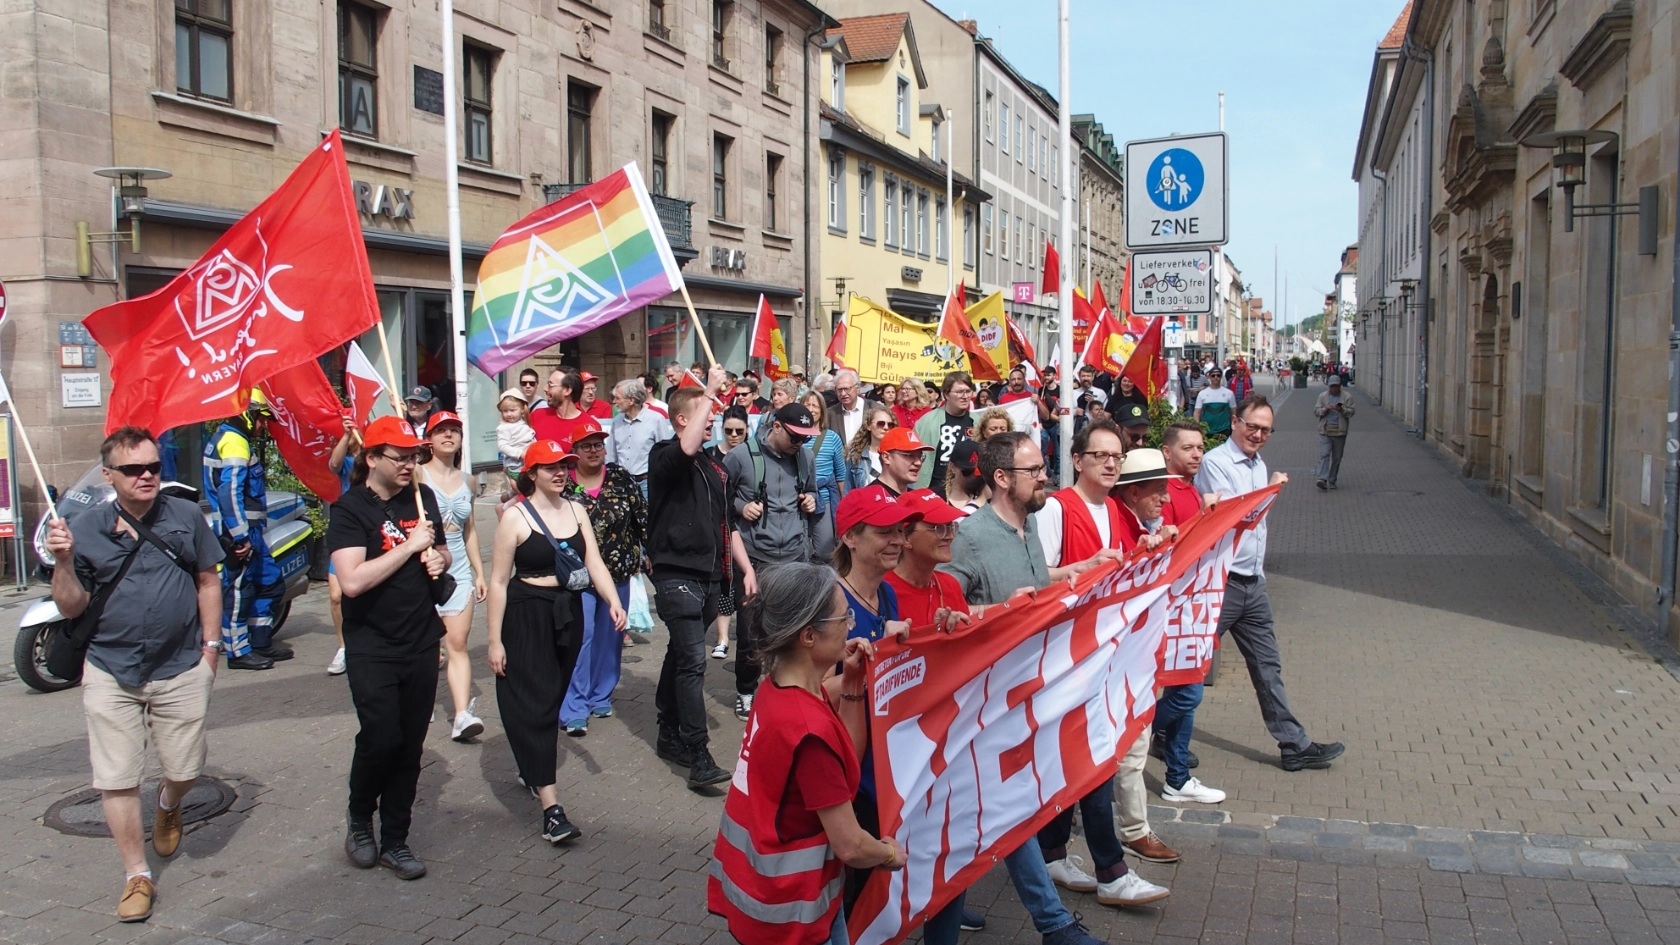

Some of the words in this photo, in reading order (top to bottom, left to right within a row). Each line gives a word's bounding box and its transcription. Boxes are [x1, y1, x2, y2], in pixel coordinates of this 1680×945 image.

[353, 180, 415, 219] RAX
[710, 245, 746, 270] BRAX
[1189, 278, 1205, 287] frei
[883, 322, 904, 334] Mai
[981, 332, 996, 342] DIDF
[881, 347, 917, 361] Mayıs
[281, 553, 306, 578] LIZEI
[876, 662, 922, 704] #TARIFWENDE
